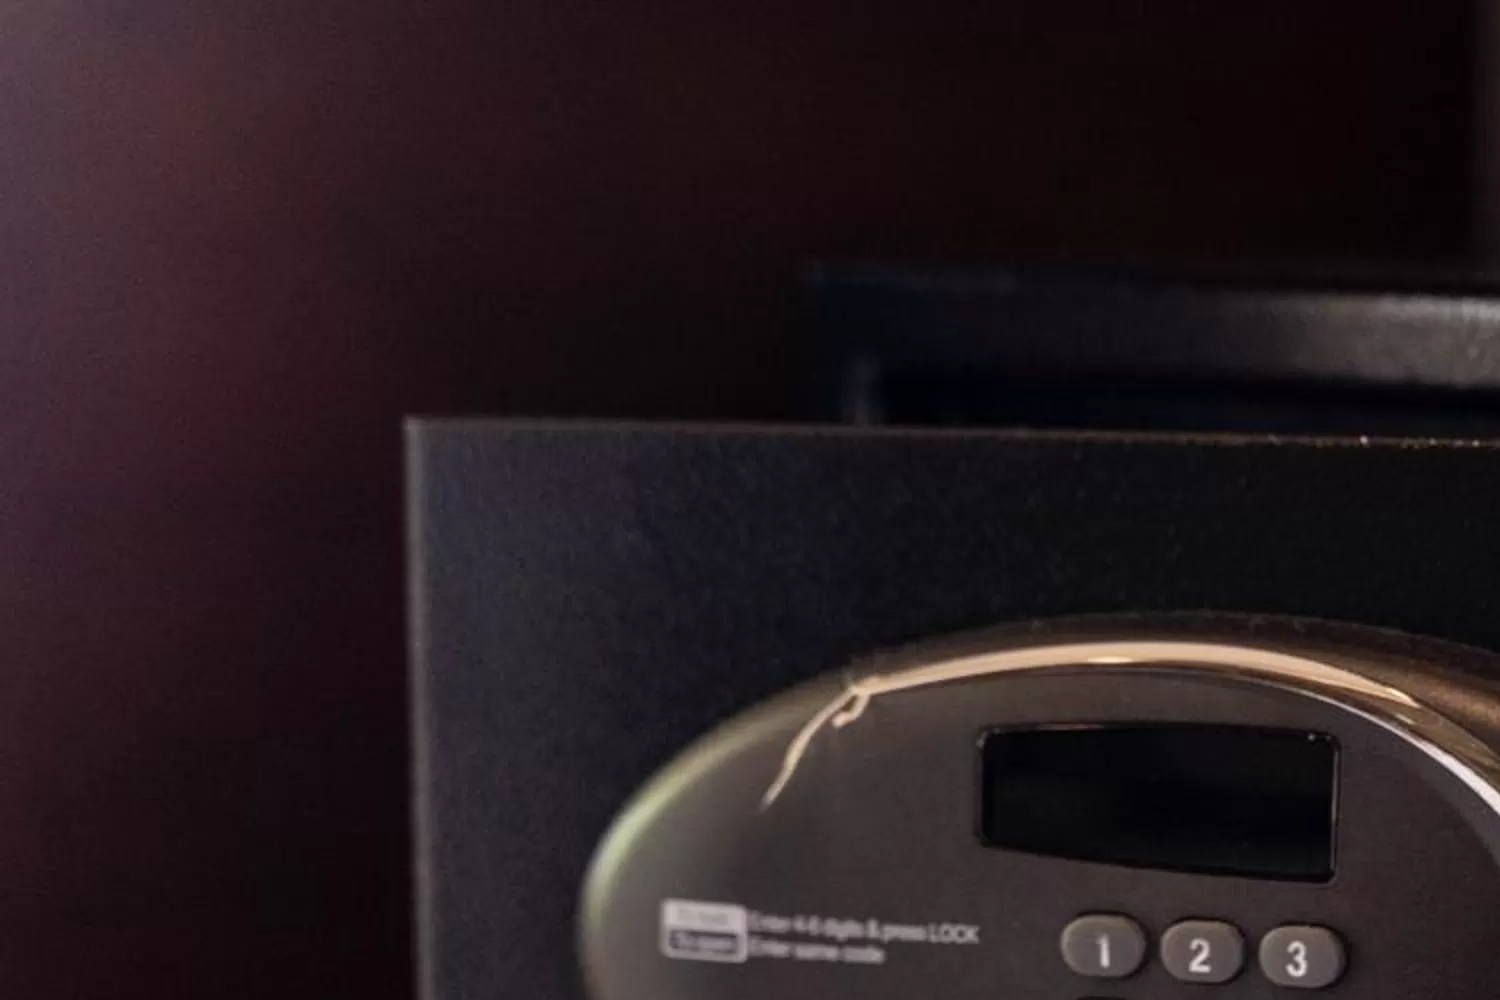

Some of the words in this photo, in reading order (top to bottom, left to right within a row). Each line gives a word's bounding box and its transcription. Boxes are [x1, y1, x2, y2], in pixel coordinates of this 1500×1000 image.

[928, 922, 980, 945] LOCK
[1096, 934, 1110, 969] 1
[1188, 938, 1212, 973] 2
[1286, 941, 1309, 978] 3
